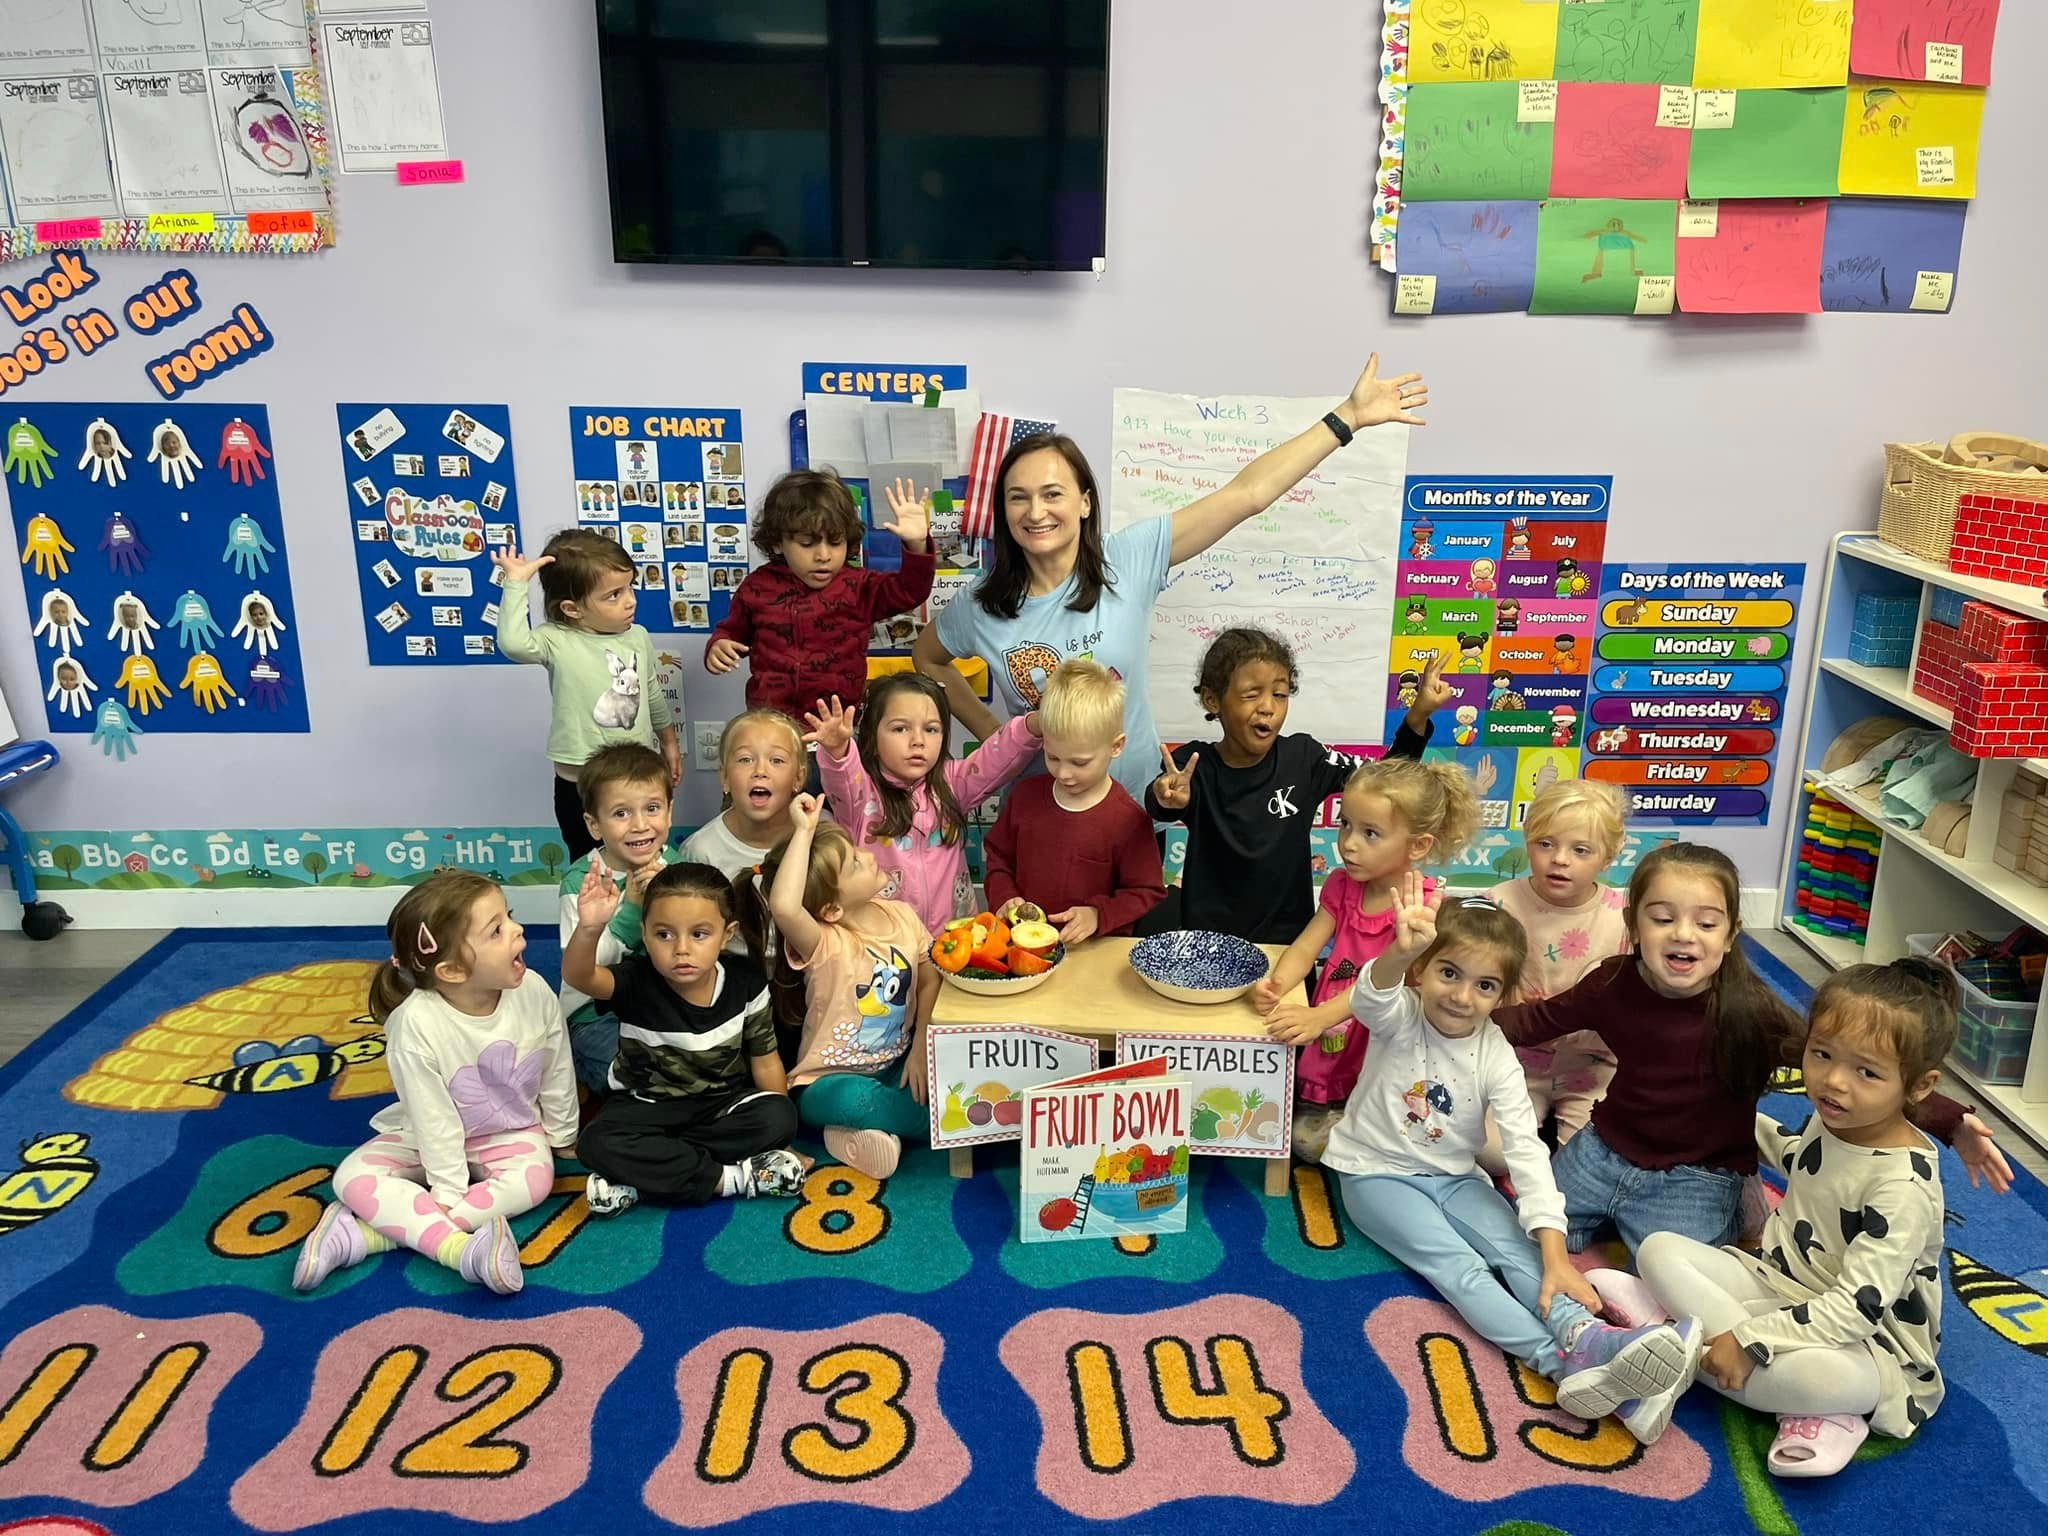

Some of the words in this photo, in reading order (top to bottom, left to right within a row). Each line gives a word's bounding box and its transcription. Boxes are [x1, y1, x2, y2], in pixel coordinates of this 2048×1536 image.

[335, 26, 393, 46] September
[114, 76, 171, 95] September
[220, 70, 276, 87] September
[4, 81, 61, 101] September
[407, 167, 452, 180] Sonia
[152, 215, 199, 229] Ariana
[254, 214, 309, 232] Sofia
[2, 253, 93, 322] Look
[0, 330, 66, 393] oo's
[67, 311, 115, 353] in
[129, 275, 193, 329] our
[152, 307, 264, 395] room!
[820, 372, 944, 393] CENTERS
[1254, 405, 1269, 424] 3
[584, 415, 630, 437] JOB
[643, 417, 726, 438] CHART
[1424, 489, 1492, 505] Months
[1494, 489, 1514, 505] of
[1516, 490, 1546, 505] the
[1550, 490, 1591, 505] Year
[386, 496, 484, 528] Classroom
[930, 521, 948, 531] Play
[415, 526, 461, 547] Rules
[1443, 534, 1492, 548] January
[1551, 535, 1577, 548] July
[931, 577, 967, 588] ibrar
[1406, 573, 1460, 585] February
[1508, 574, 1548, 586] August
[1620, 572, 1669, 591] Days
[1670, 572, 1690, 588] of
[1688, 572, 1725, 588] the
[1728, 572, 1784, 588] Week
[1442, 612, 1478, 622] March
[1526, 612, 1588, 624] September
[1662, 605, 1736, 624] Sunday
[1065, 640, 1079, 652] is
[1083, 630, 1104, 650] for
[1654, 637, 1735, 656] Monday
[1409, 648, 1439, 660] April
[1499, 650, 1544, 660] October
[1650, 670, 1732, 688] Tuesday
[1524, 687, 1581, 697] November
[1630, 702, 1744, 720] Wednesday
[1489, 723, 1546, 733] December
[1638, 733, 1728, 751] Thursday
[1647, 764, 1708, 782] Friday
[1632, 795, 1717, 812] Saturday
[82, 843, 121, 866] Bb
[151, 843, 189, 866] Cc
[208, 841, 250, 866] Dd
[264, 843, 300, 866] Ee
[327, 840, 355, 864] Ff
[385, 841, 426, 869] Gg
[455, 839, 495, 863] Hh
[508, 839, 533, 863] Ii
[968, 1039, 1059, 1070] FRUITS
[1130, 1044, 1279, 1074] VEGETABLES
[260, 1061, 304, 1087] A
[1030, 1093, 1104, 1149] FRUIT
[1112, 1088, 1184, 1143] BOWL
[206, 1163, 337, 1259] 6
[783, 1160, 891, 1255] 8
[0, 1342, 210, 1472] 11
[312, 1342, 562, 1478] 12
[695, 1341, 917, 1484] 13
[1065, 1333, 1291, 1474] 14
